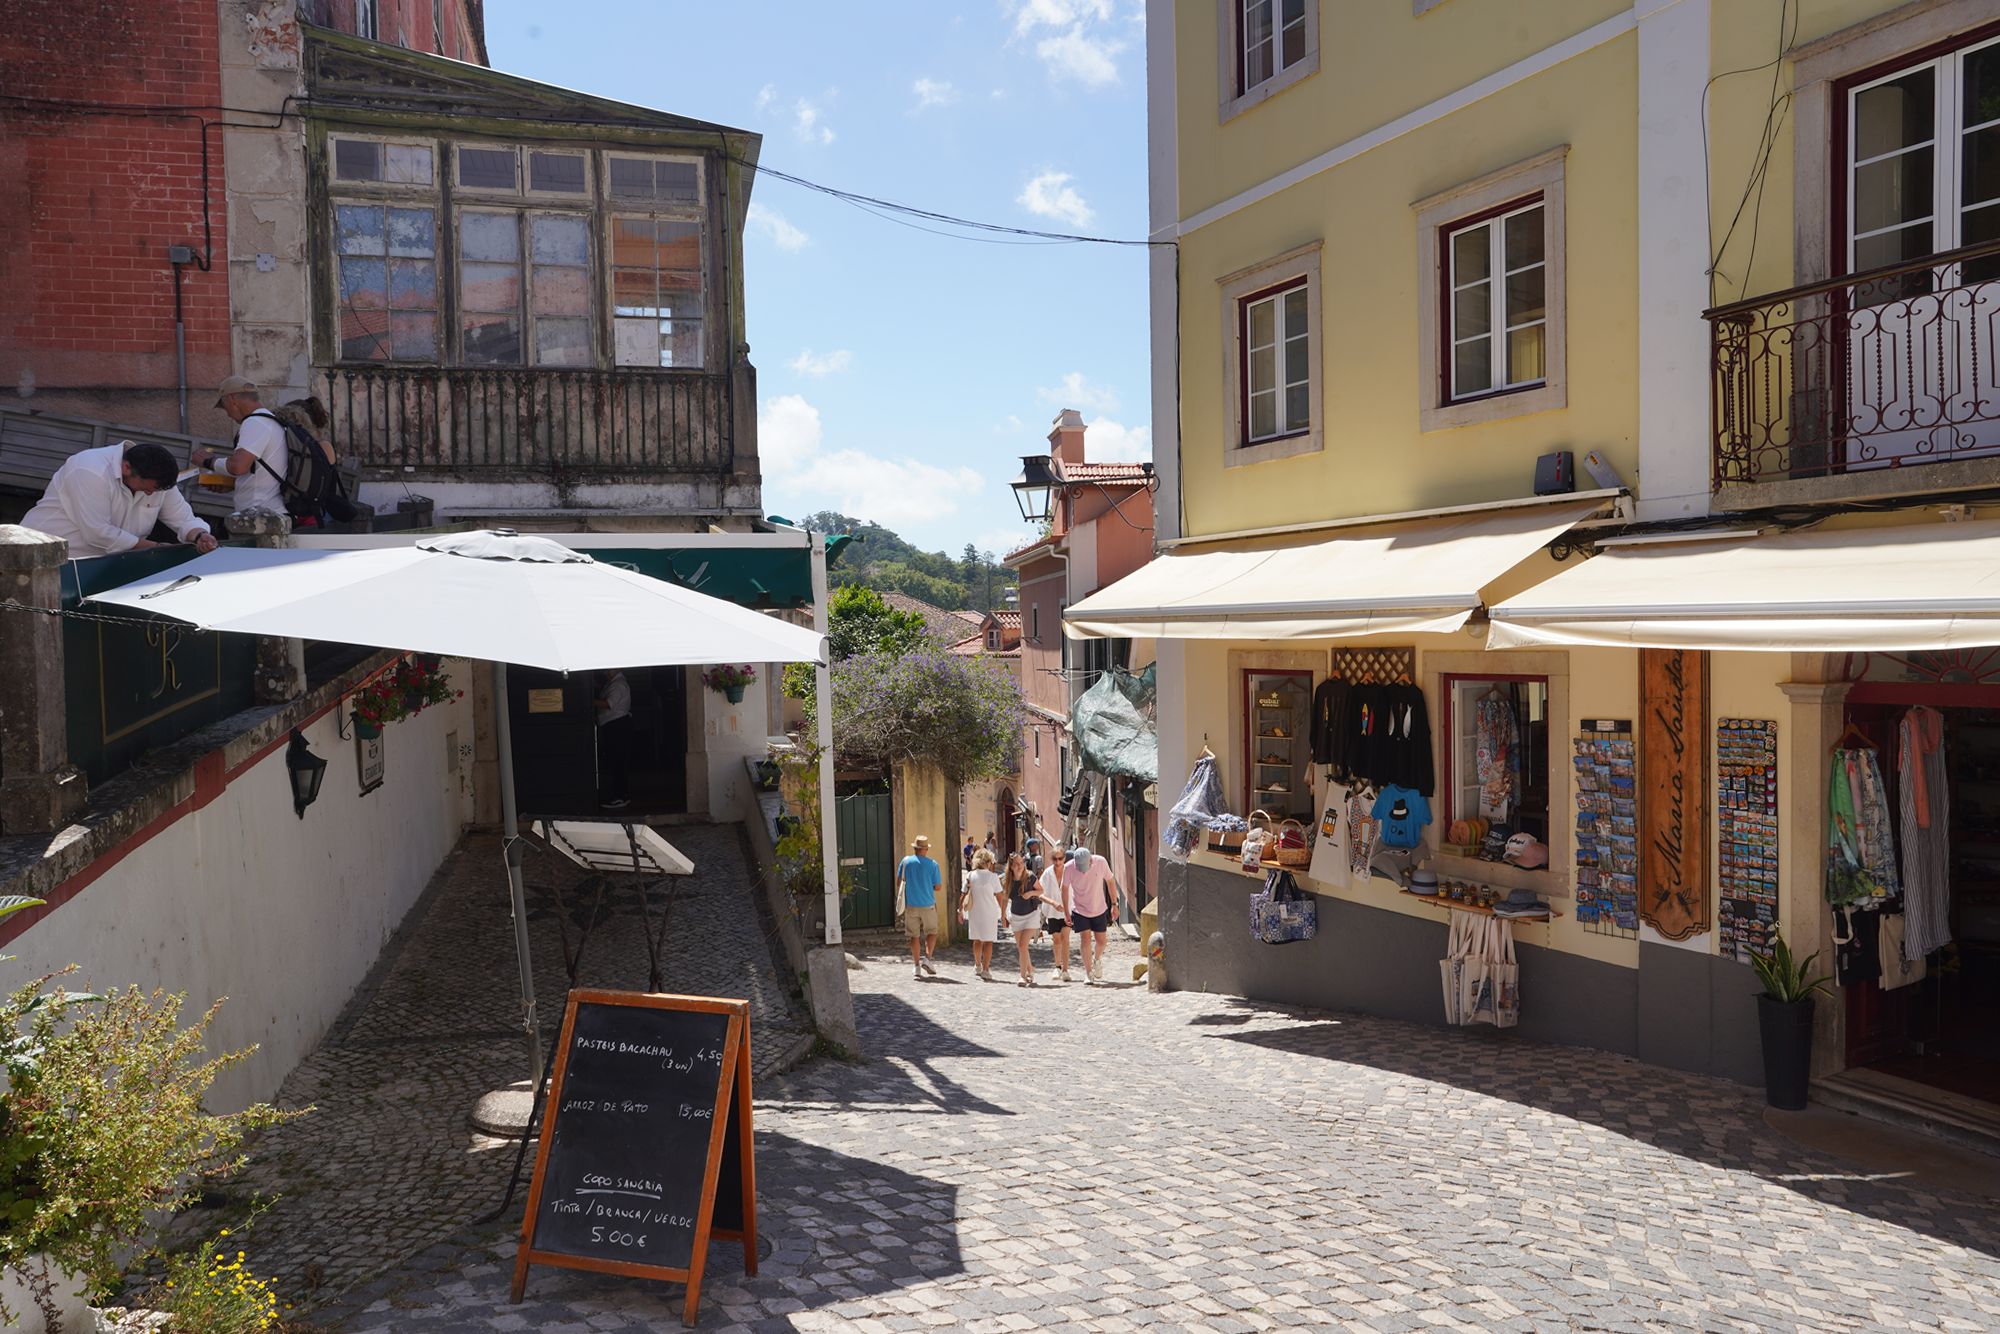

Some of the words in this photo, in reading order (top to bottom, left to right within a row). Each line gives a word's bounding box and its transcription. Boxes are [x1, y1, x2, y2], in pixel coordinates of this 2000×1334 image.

[1655, 770, 1684, 887] Maria
[577, 1036, 616, 1051] PASTEIS
[562, 1099, 595, 1112] ARROZ
[603, 1101, 617, 1112] DE
[621, 1099, 649, 1113] PATO
[654, 1213, 693, 1228] VERDE
